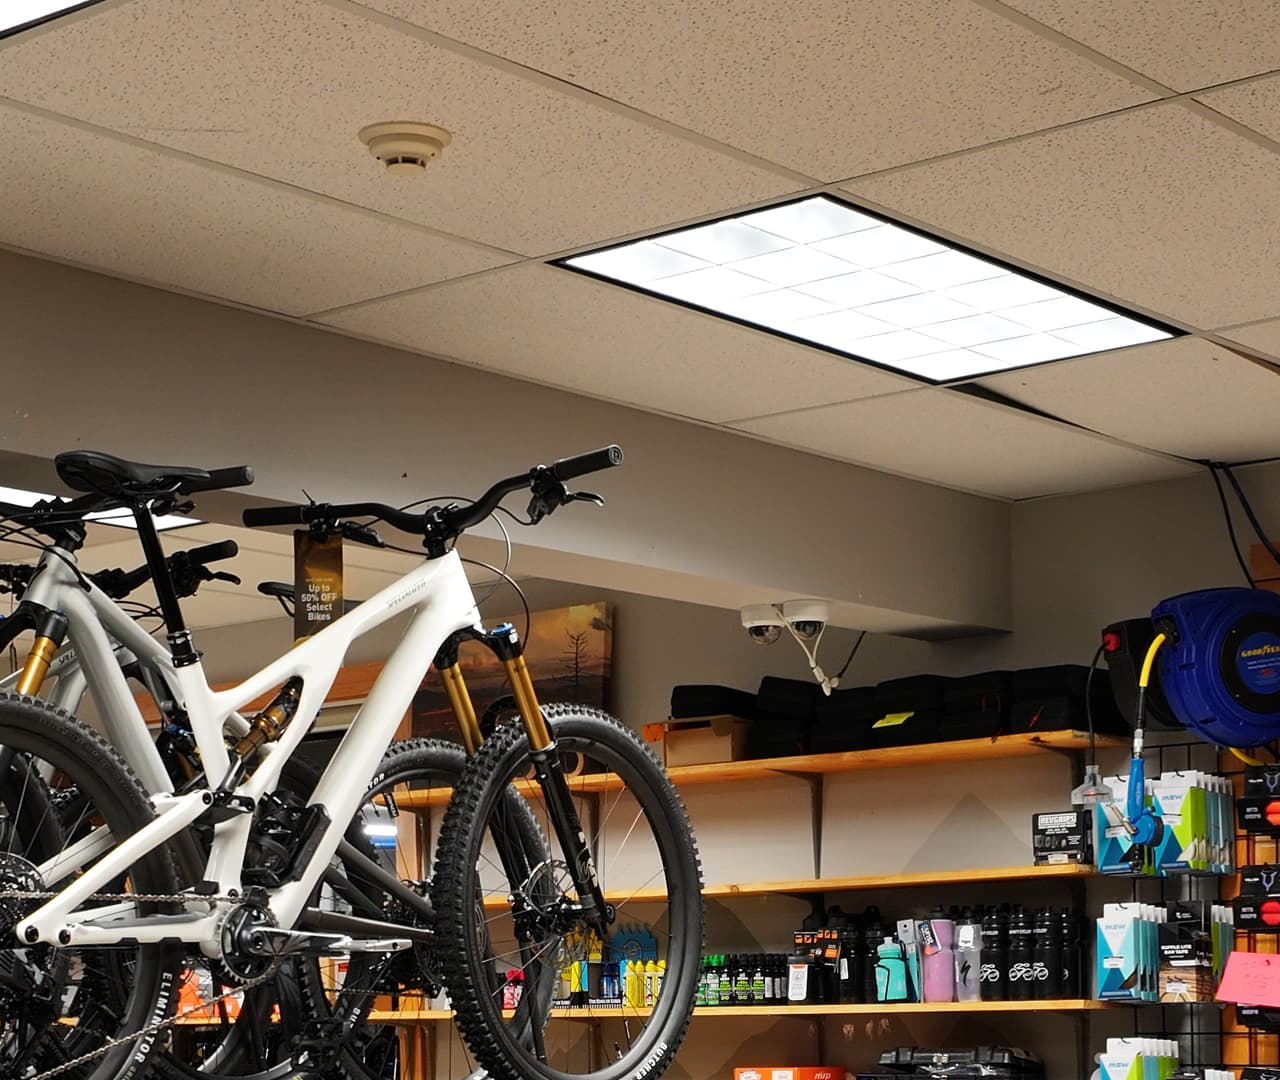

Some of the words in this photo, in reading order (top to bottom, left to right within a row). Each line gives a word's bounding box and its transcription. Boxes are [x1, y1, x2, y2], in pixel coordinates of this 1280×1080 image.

[308, 584, 321, 594] Up
[322, 584, 330, 592] to
[301, 593, 319, 602] 50%
[320, 592, 338, 602] OFF
[305, 602, 333, 612] Select
[307, 612, 332, 621] Bikes
[133, 971, 174, 1065] ELIMINTOR
[635, 1041, 668, 1080] BUTCHER
